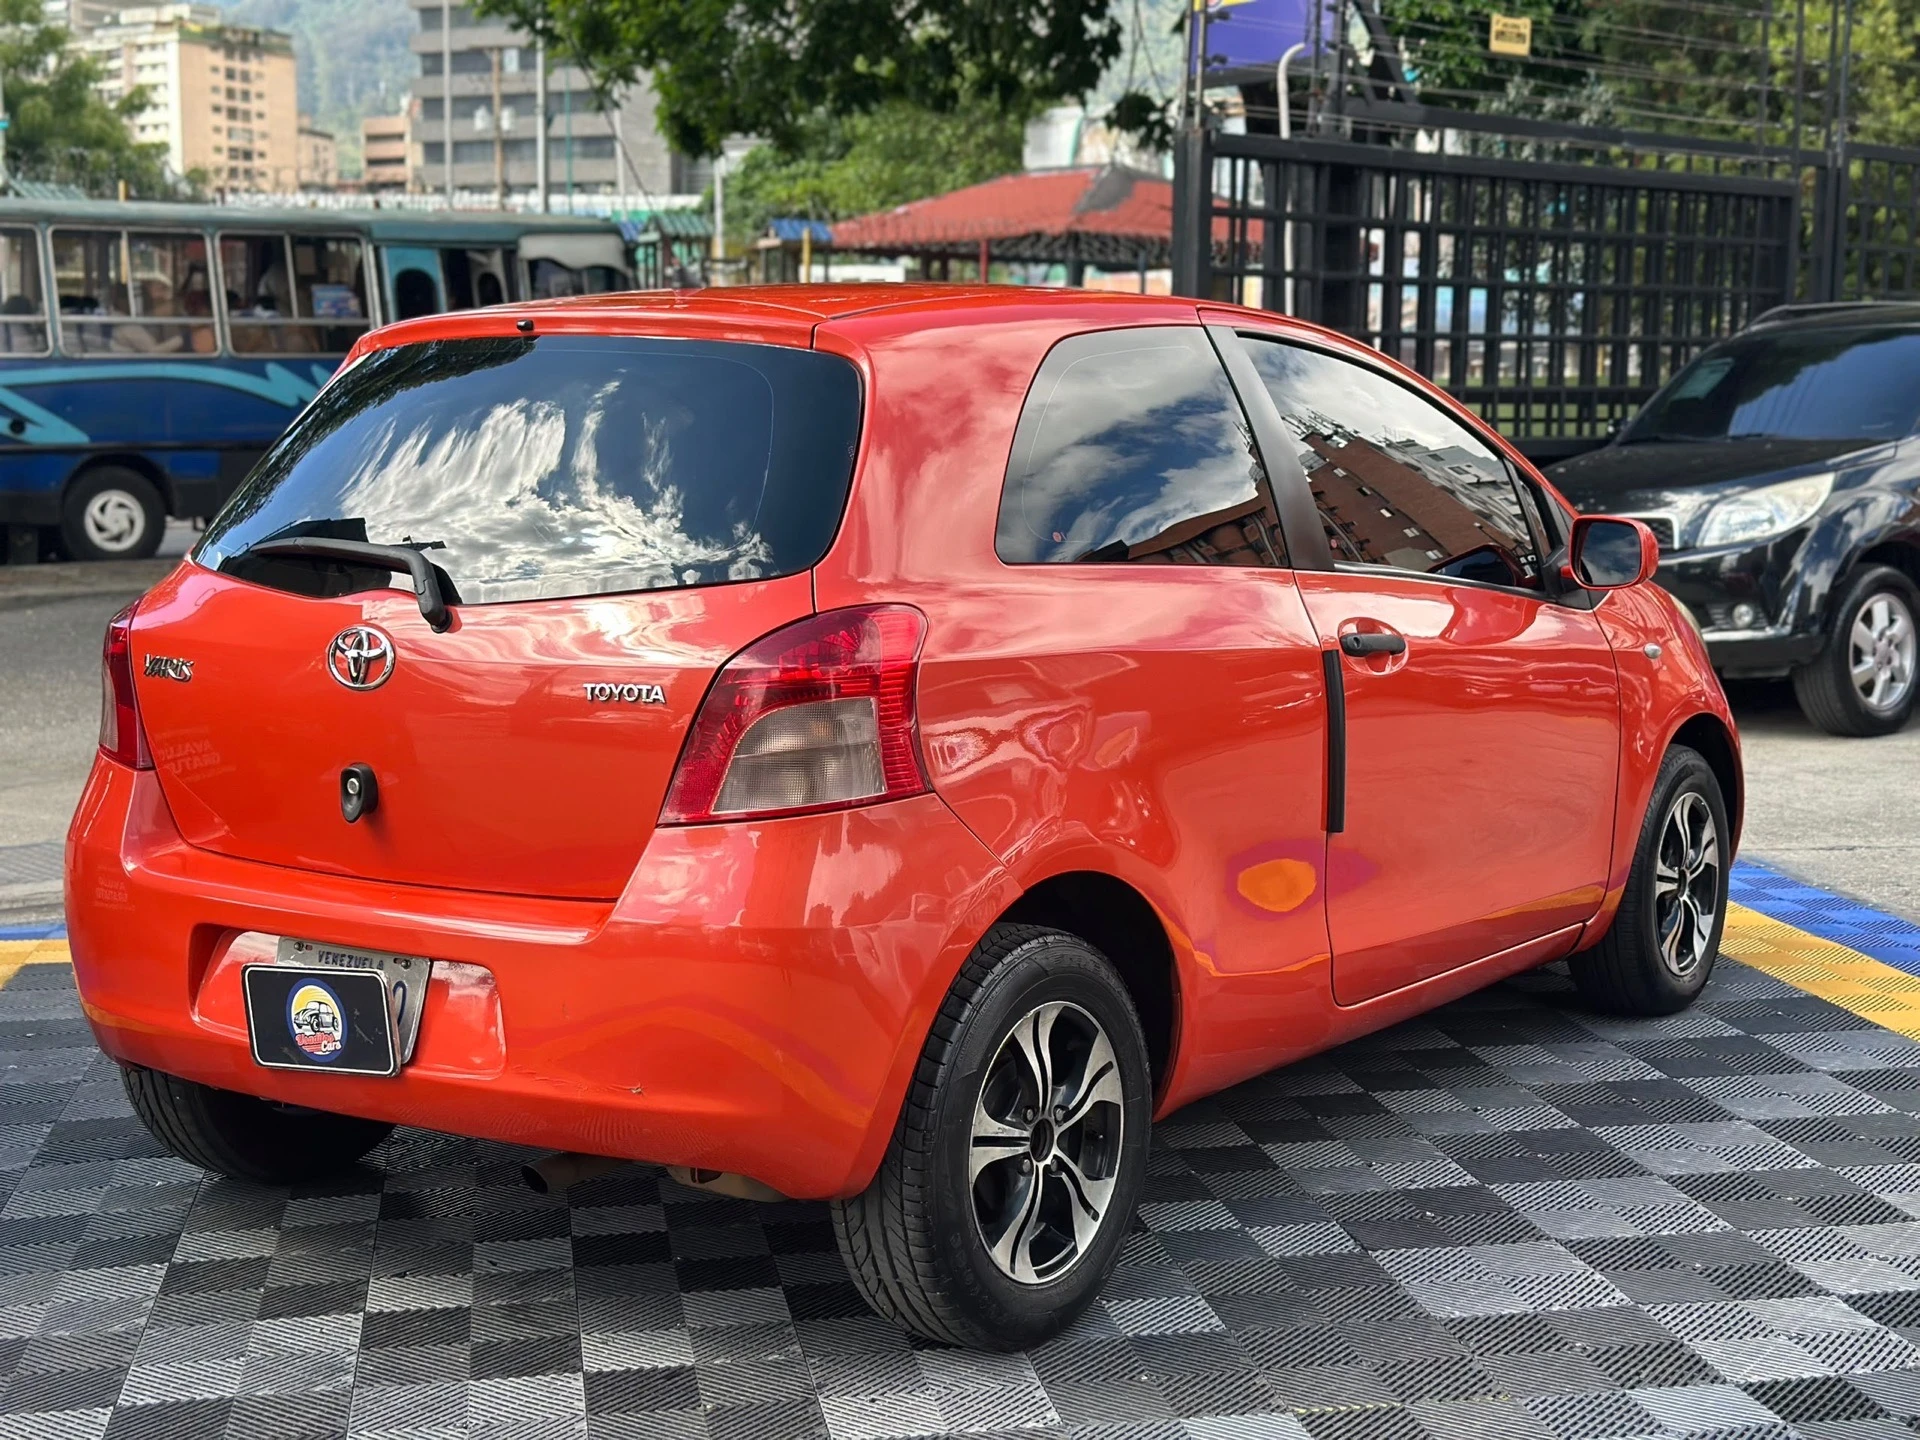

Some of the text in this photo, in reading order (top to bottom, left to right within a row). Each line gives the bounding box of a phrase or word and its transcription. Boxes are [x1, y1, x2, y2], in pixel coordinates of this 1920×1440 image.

[144, 653, 194, 682] YARIS
[583, 683, 666, 703] TOYOTA
[318, 950, 384, 970] VENEZUELA
[321, 1040, 341, 1052] Cars
